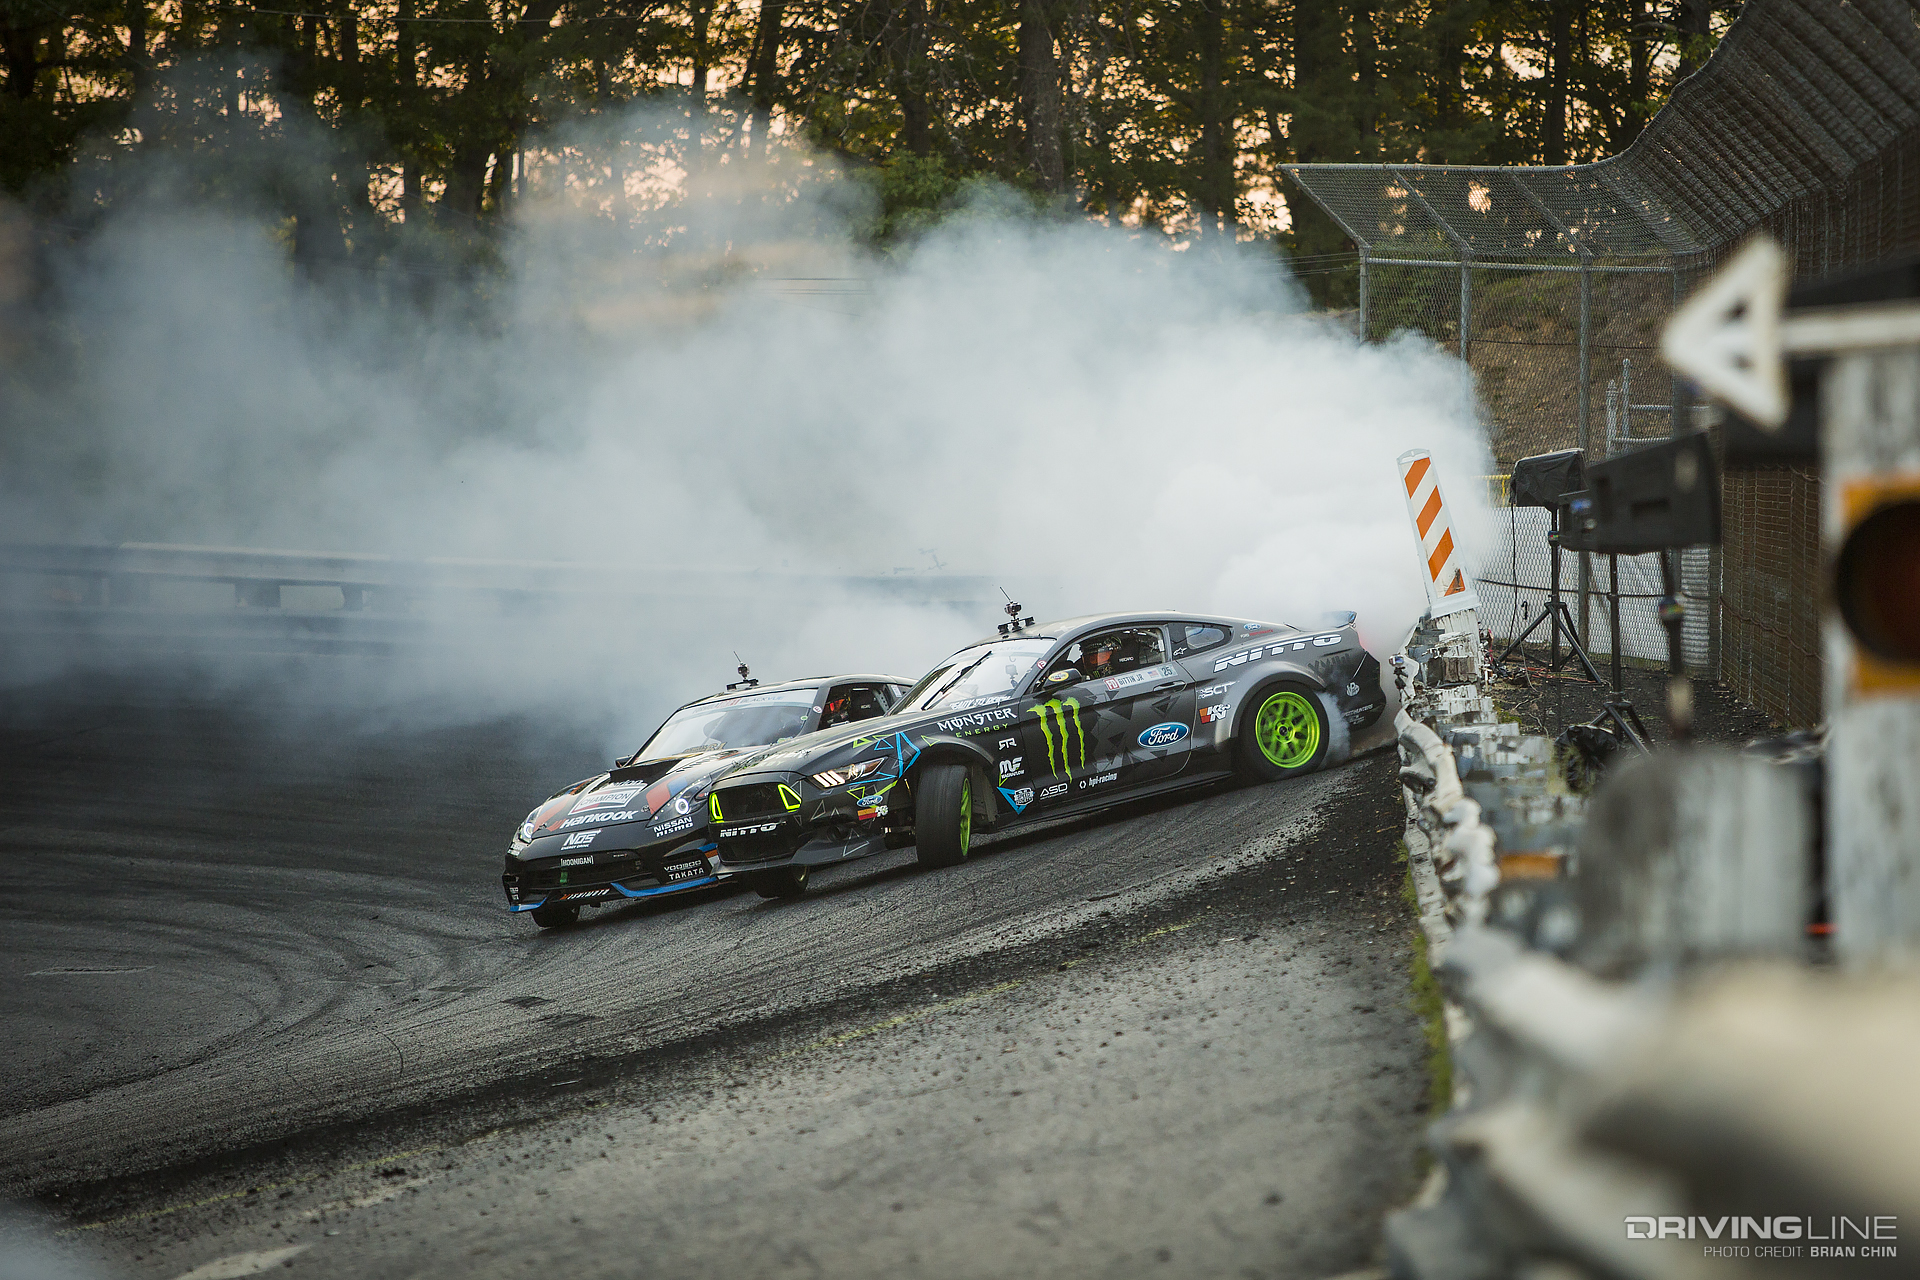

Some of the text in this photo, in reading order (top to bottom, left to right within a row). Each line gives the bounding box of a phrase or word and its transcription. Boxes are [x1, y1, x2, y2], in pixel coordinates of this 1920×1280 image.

[1213, 634, 1342, 673] NITTO
[1161, 666, 1173, 677] 25
[936, 707, 1018, 732] MONSTER
[955, 722, 1009, 738] ENERGY
[1148, 725, 1180, 746] Ford
[1040, 783, 1068, 798] ASD
[580, 792, 632, 806] CHAMPION
[653, 816, 693, 833] NISSAN
[720, 822, 780, 838] NITTO
[563, 829, 602, 847] NOS
[668, 867, 705, 881] TAKATA
